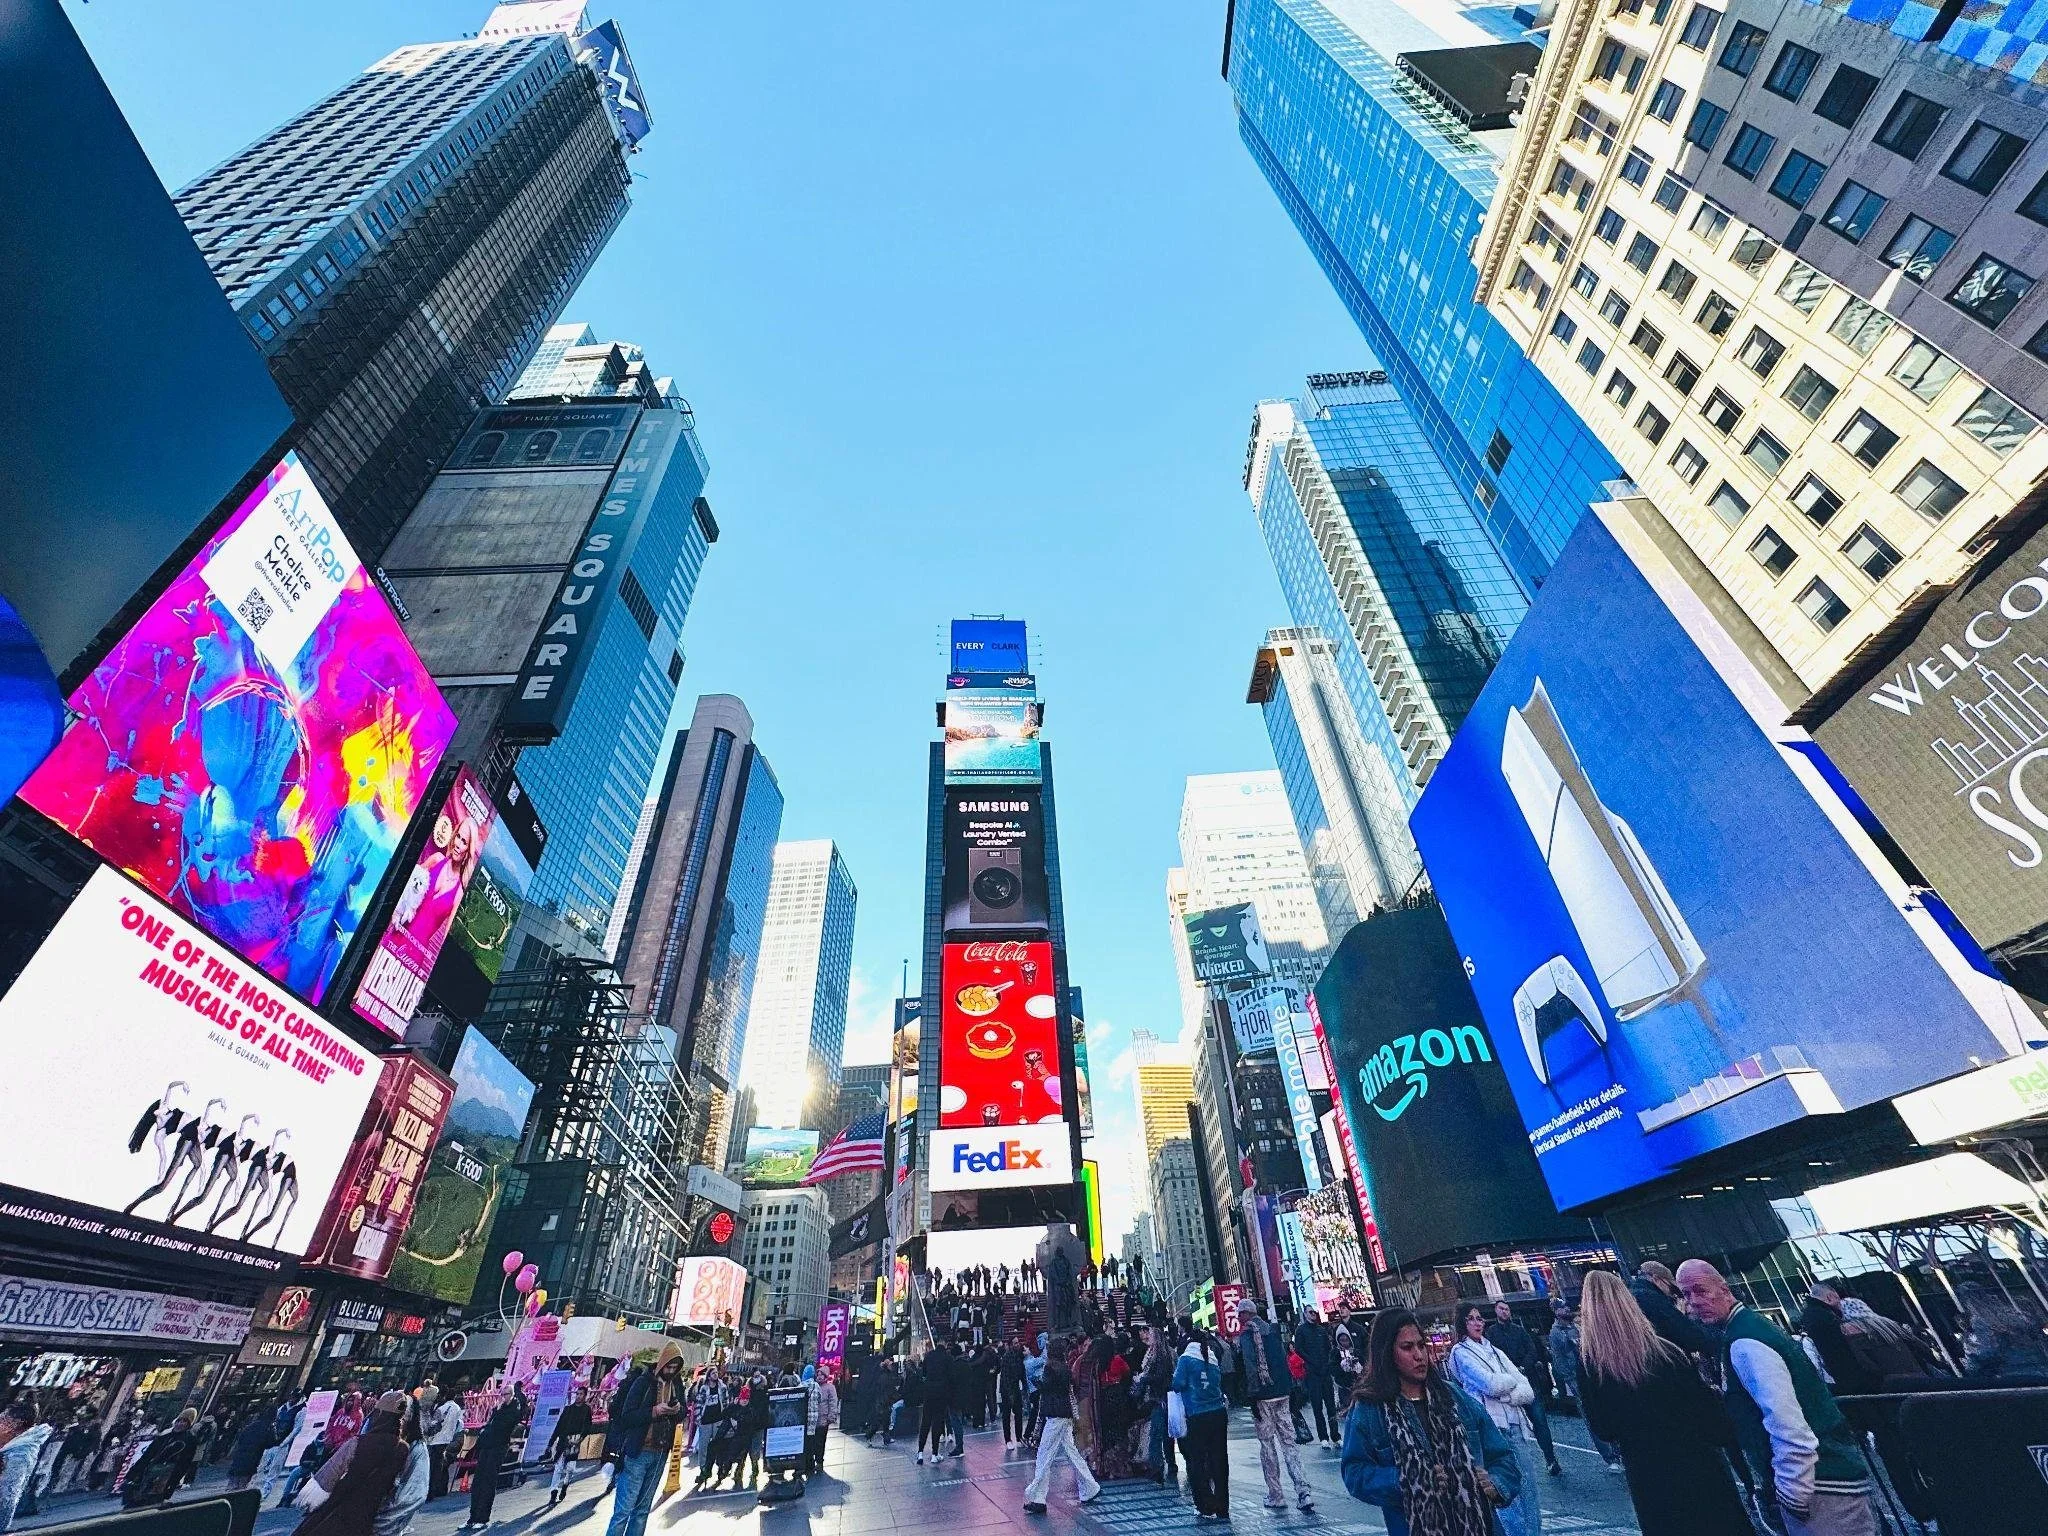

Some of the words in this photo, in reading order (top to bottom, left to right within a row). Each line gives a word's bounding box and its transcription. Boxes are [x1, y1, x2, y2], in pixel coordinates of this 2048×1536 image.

[563, 412, 615, 420] SQUARE
[601, 420, 663, 516] TIMES
[273, 497, 299, 532] STREET
[299, 535, 328, 576] GALLERY
[279, 489, 346, 583] ArtPop
[264, 548, 300, 602] Meikle
[274, 535, 312, 591] Chalice
[254, 560, 294, 613] @therealchalice
[521, 534, 612, 700] SQUARE
[1868, 557, 2048, 716] WELCO
[956, 642, 984, 650] EVERY
[992, 642, 1020, 650] CLARK
[958, 801, 1030, 813] SAMSUNG
[969, 821, 1004, 830] Bespoke
[963, 830, 996, 839] Laundry
[997, 830, 1026, 838] Vented
[483, 882, 507, 916] K-FOOD
[387, 939, 398, 955] THE
[963, 941, 1030, 963] Coca-Cola
[1195, 944, 1217, 956] Brains.
[1218, 942, 1240, 953] Heart.
[1203, 951, 1233, 961] Courage.
[365, 946, 427, 1021] VERSAILLES
[1235, 986, 1269, 1013] LITTLE
[138, 958, 242, 1031] MUSICALS
[239, 1018, 266, 1044] OF
[261, 1033, 291, 1064] ALL
[172, 939, 205, 969] OF
[201, 956, 240, 994] THE
[236, 981, 287, 1024] MOST
[284, 1012, 366, 1077] CAPTIVATING
[207, 1030, 227, 1048] MAIL
[228, 1041, 234, 1050] &
[235, 1046, 271, 1071] GUARDIAN
[1273, 1004, 1304, 1091] mobile
[1358, 1025, 1493, 1105] amazon
[1529, 1099, 1591, 1144] /games/battlefield-6
[1588, 1094, 1603, 1109] for
[1600, 1082, 1627, 1103] details.
[1553, 1128, 1573, 1146] Stand
[1570, 1122, 1586, 1139] sold
[1584, 1105, 1623, 1136] separately.
[454, 1154, 483, 1182] K-FOOD
[953, 1139, 1044, 1174] FedEx
[1342, 1135, 1376, 1225] CHOCOLATE
[0, 1202, 68, 1227] AMBASSADOR
[67, 1217, 105, 1235] THEATRE
[110, 1227, 130, 1240] 49TH
[130, 1231, 142, 1243] ST.
[143, 1234, 154, 1245] AT
[153, 1235, 193, 1253] BROADWAY
[197, 1245, 209, 1256] NO
[208, 1248, 223, 1260] FEES
[223, 1251, 233, 1261] AT
[232, 1252, 245, 1263] THE
[243, 1254, 255, 1266] BOX
[255, 1257, 274, 1270] OFFICE
[1311, 1243, 1363, 1281] KEVANI
[162, 1311, 183, 1323] GIFTS
[163, 1300, 201, 1313] DISCOUNT
[339, 1299, 366, 1319] BLUE
[365, 1304, 385, 1321] FIN
[1221, 1287, 1242, 1334] tkts
[151, 1322, 192, 1336] SOUVENIRS
[258, 1341, 293, 1358] HEYTEA
[823, 1308, 845, 1353] tkts
